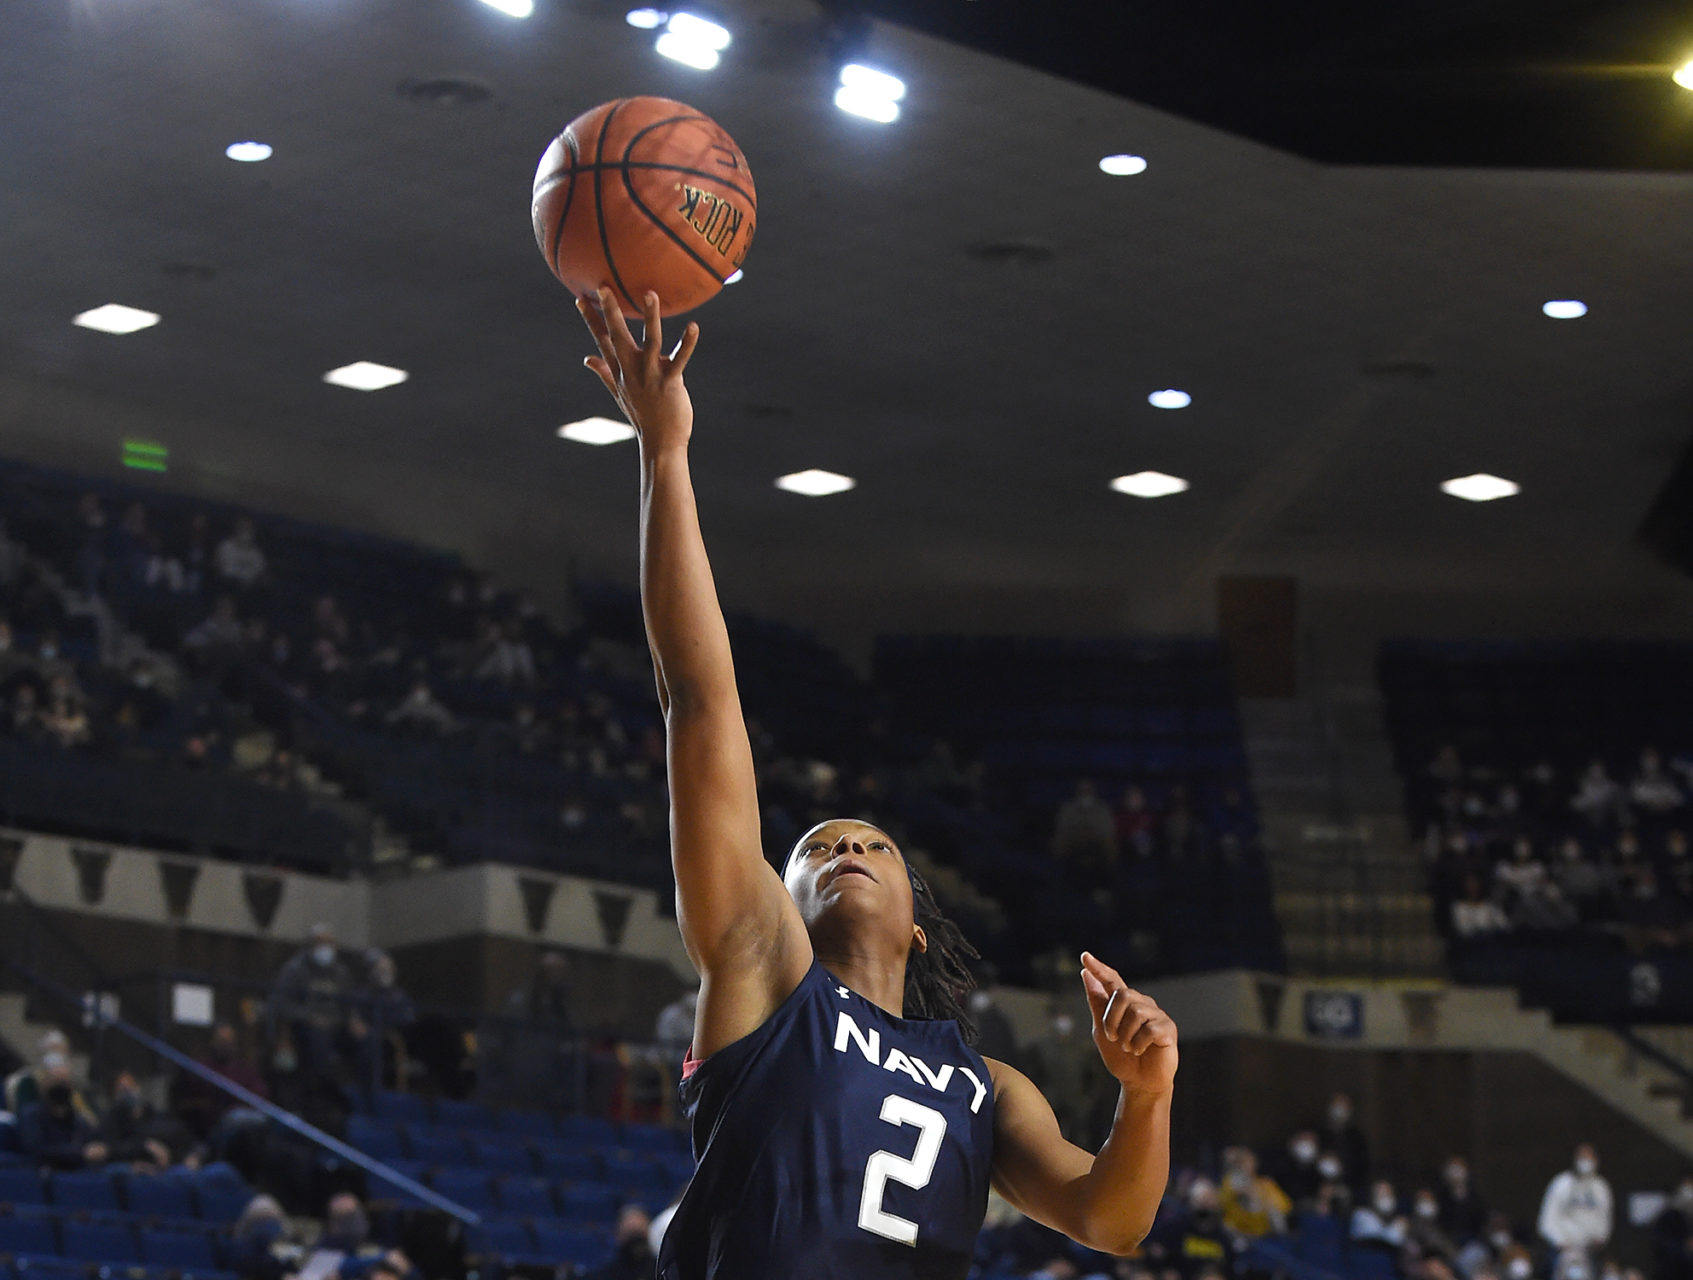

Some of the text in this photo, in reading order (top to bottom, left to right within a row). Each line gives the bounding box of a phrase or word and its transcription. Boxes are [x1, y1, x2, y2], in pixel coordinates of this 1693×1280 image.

[678, 184, 744, 257] ROCK
[834, 1011, 988, 1115] NAVY
[857, 1093, 948, 1248] 2
